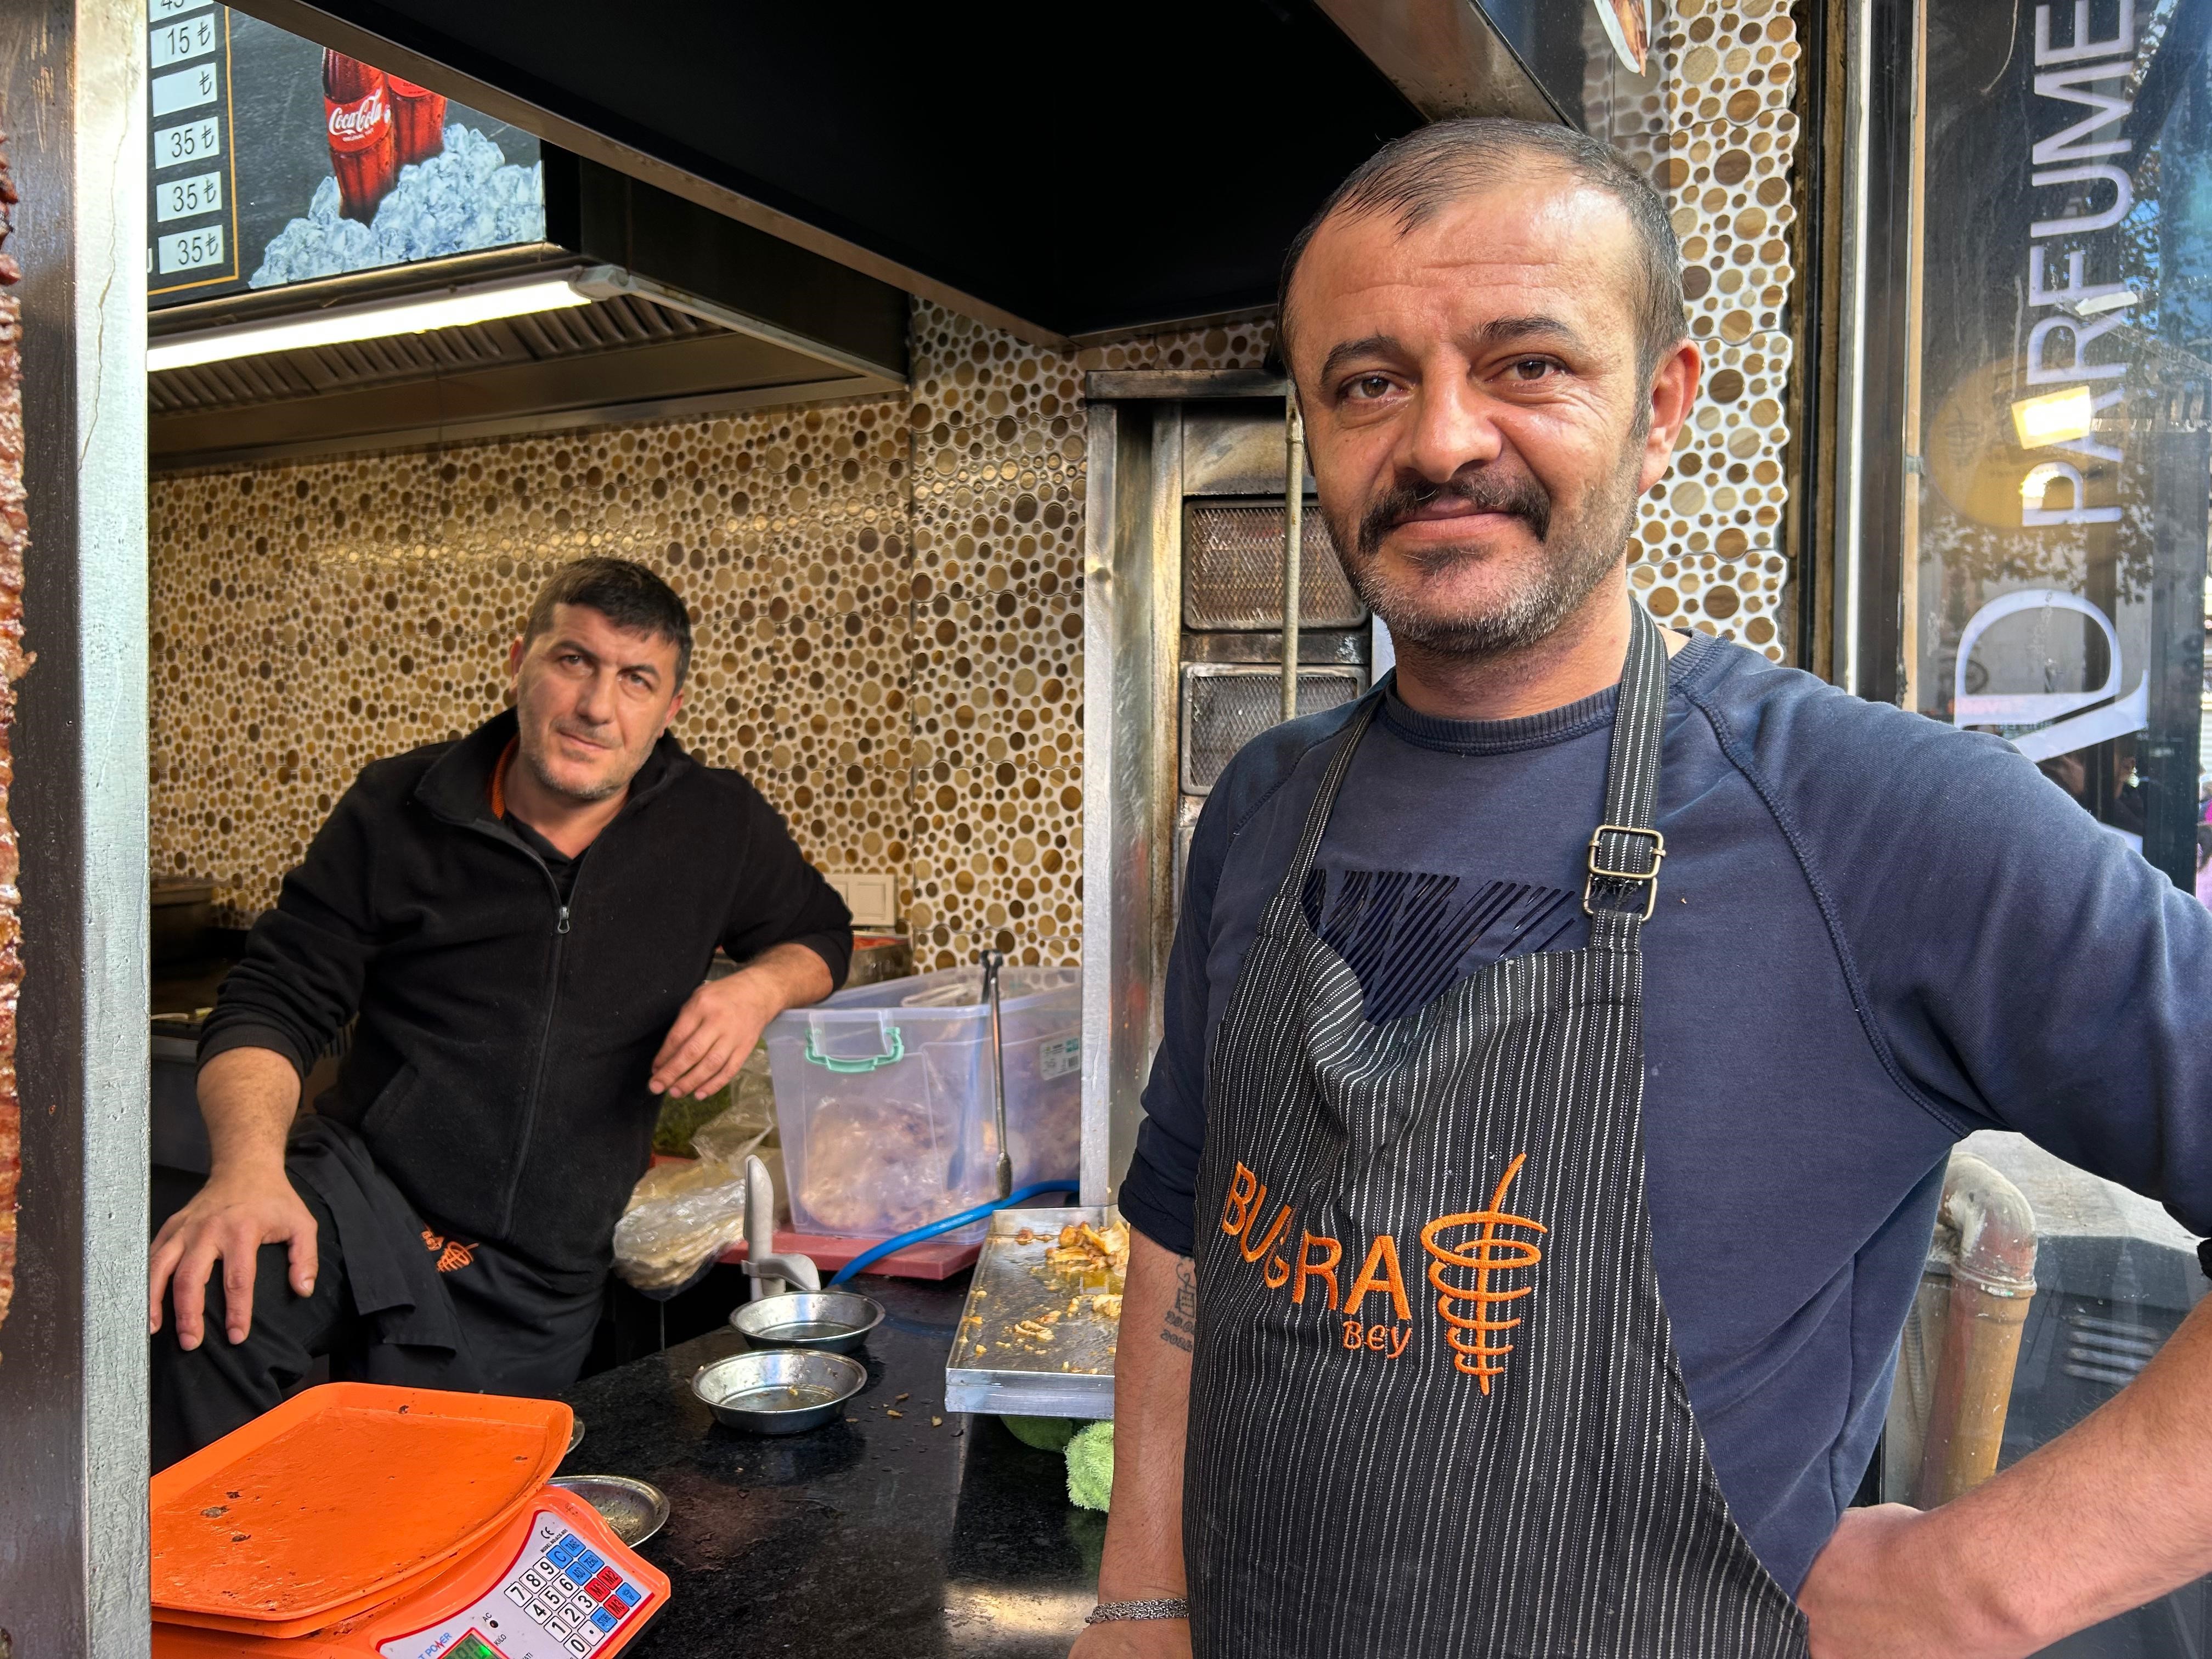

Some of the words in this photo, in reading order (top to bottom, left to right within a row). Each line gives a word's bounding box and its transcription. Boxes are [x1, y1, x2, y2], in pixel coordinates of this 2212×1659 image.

[167, 26, 189, 55] 15
[171, 128, 195, 157] 35
[173, 183, 198, 212] 35
[1342, 1321, 1411, 1359] Bey
[510, 1586, 525, 1600] 7
[526, 1573, 540, 1587] 8
[539, 1561, 554, 1575] 9
[554, 1551, 566, 1562] C
[565, 1538, 580, 1551] TARE
[533, 1604, 546, 1616] 4
[544, 1590, 560, 1605] 5
[559, 1578, 574, 1592] 6
[572, 1567, 586, 1579] ADD
[584, 1554, 599, 1569] ZERO
[551, 1621, 566, 1634] 1
[565, 1608, 580, 1623] 2
[578, 1595, 592, 1609] 3
[590, 1582, 604, 1597] M1
[602, 1570, 619, 1585] M2
[482, 1612, 492, 1622] AC
[571, 1638, 585, 1652] 0
[597, 1612, 611, 1627] STORE
[608, 1599, 625, 1614] M3
[425, 1632, 453, 1657] POWER
[494, 1633, 507, 1646] KILO
